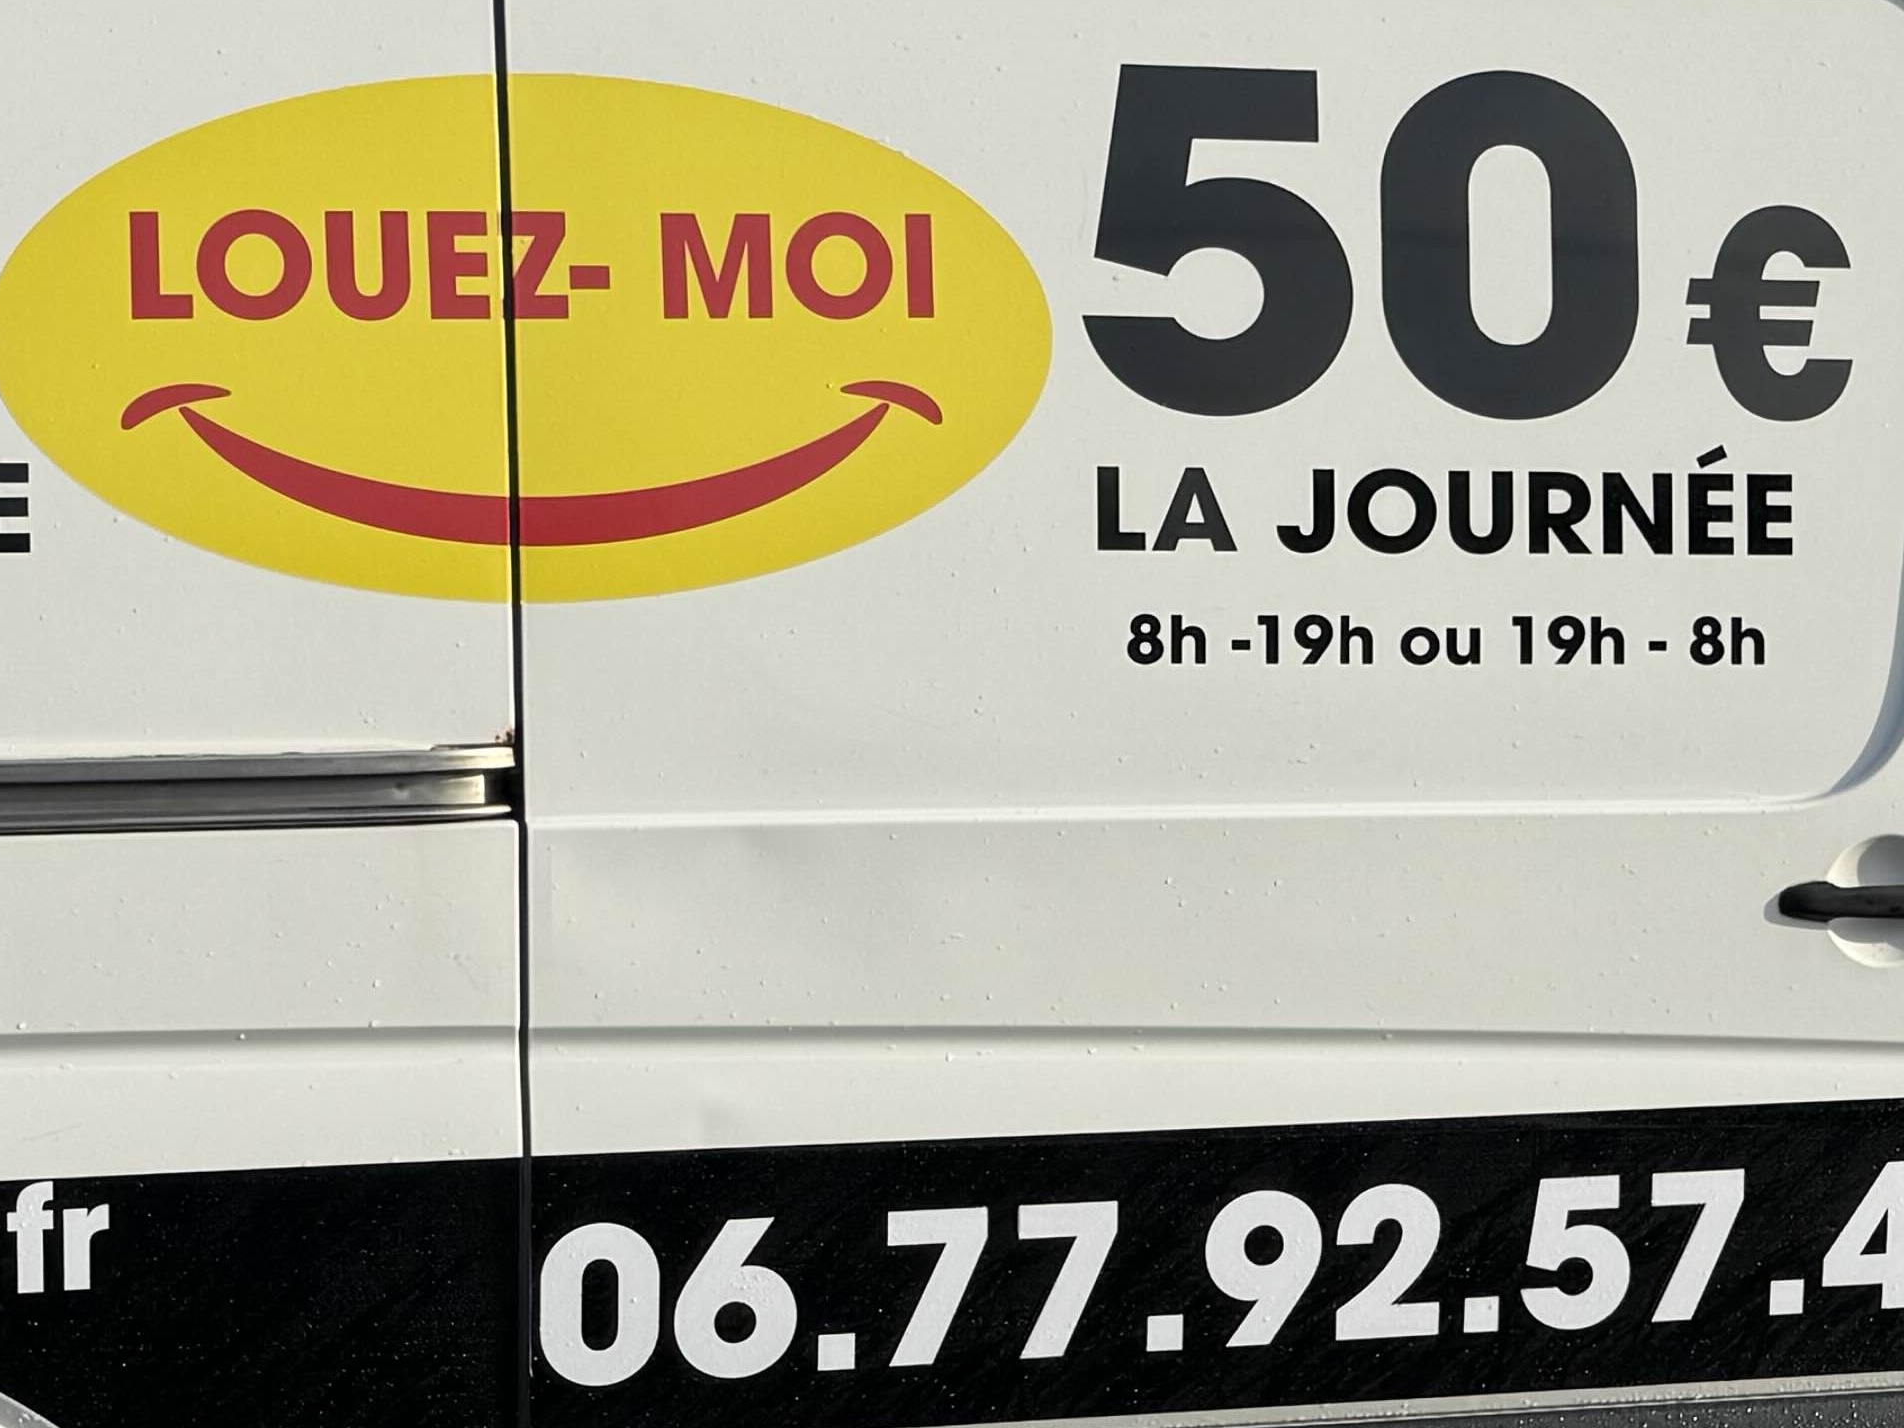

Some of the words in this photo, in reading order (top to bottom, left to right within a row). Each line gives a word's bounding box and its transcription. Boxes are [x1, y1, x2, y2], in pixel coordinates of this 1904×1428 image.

[661, 212, 933, 318] MOI
[1096, 466, 1238, 552] LA
[1276, 444, 1793, 556] JOURNÉE
[1126, 613, 1207, 665] 8h
[1400, 626, 1481, 666] ou
[1511, 615, 1625, 665] 19h
[1689, 615, 1765, 666] 8h
